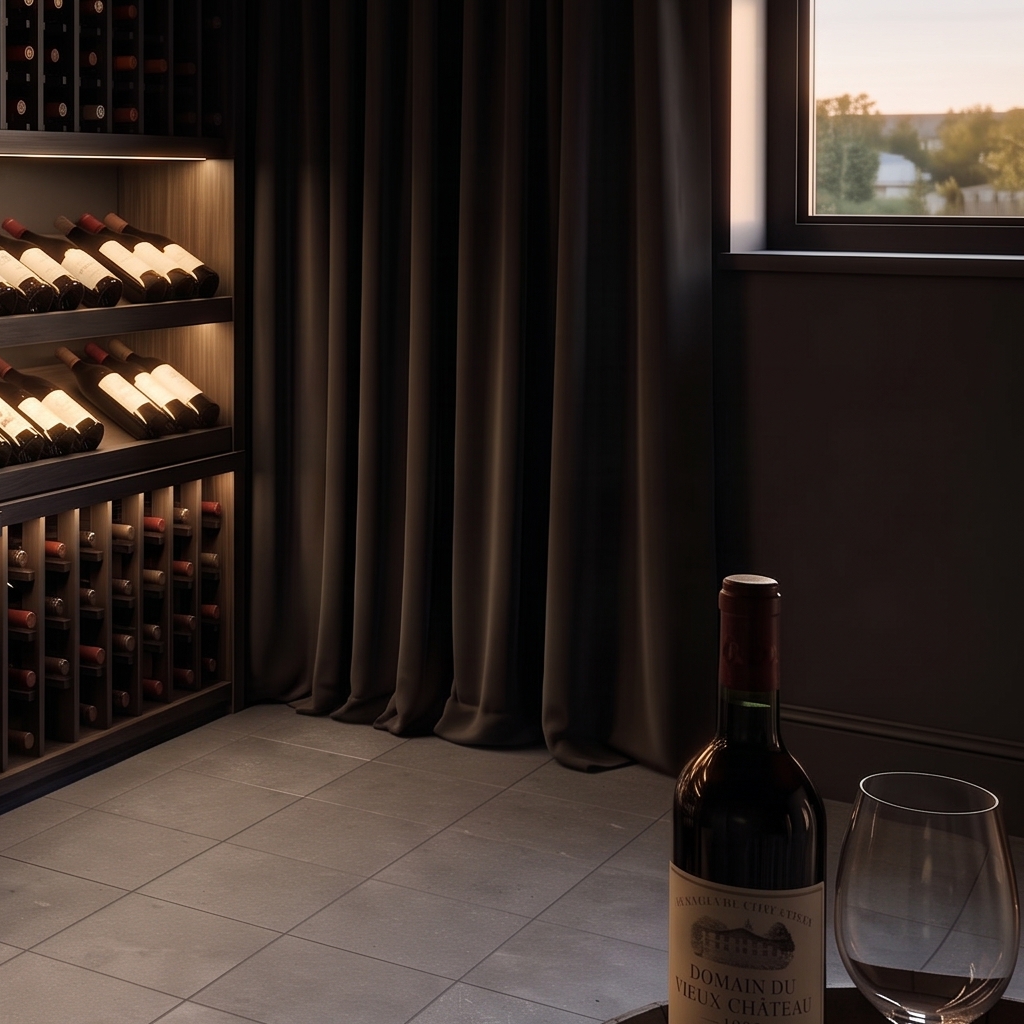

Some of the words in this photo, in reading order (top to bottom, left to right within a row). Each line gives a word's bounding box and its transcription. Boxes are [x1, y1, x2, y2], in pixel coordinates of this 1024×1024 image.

[675, 975, 721, 1010] VIEUX
[728, 997, 812, 1017] CHÂTEAU
[690, 963, 765, 995] DOMAIN
[771, 978, 796, 995] DU
